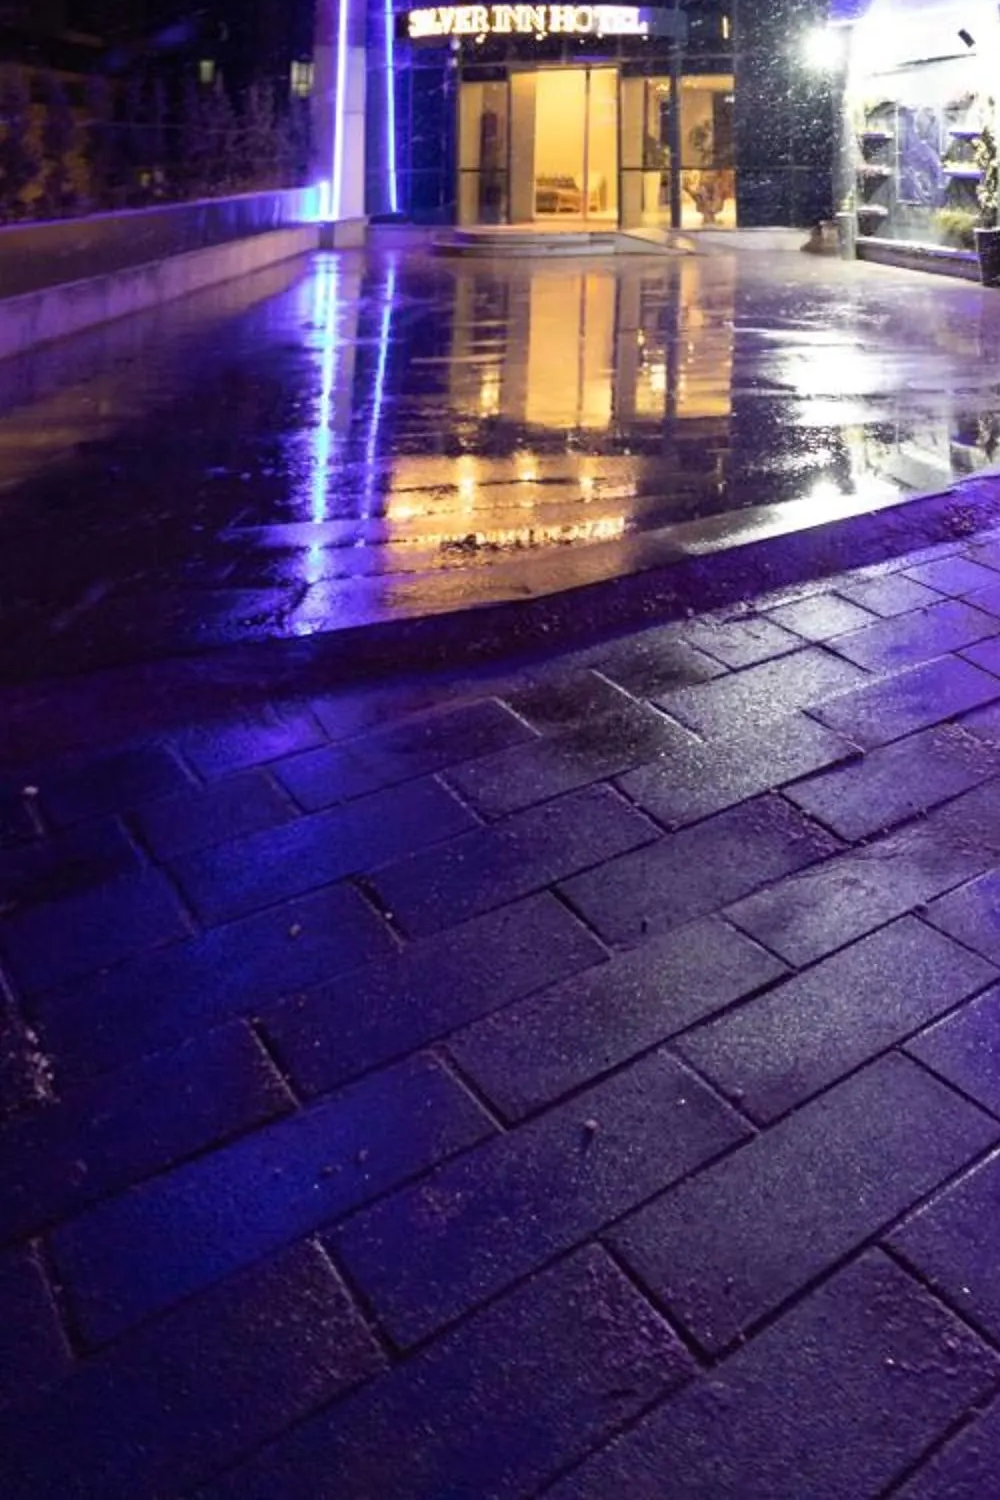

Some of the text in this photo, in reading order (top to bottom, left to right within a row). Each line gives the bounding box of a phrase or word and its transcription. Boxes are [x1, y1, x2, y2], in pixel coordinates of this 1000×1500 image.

[409, 4, 648, 37] SILVER INN HOTEL
